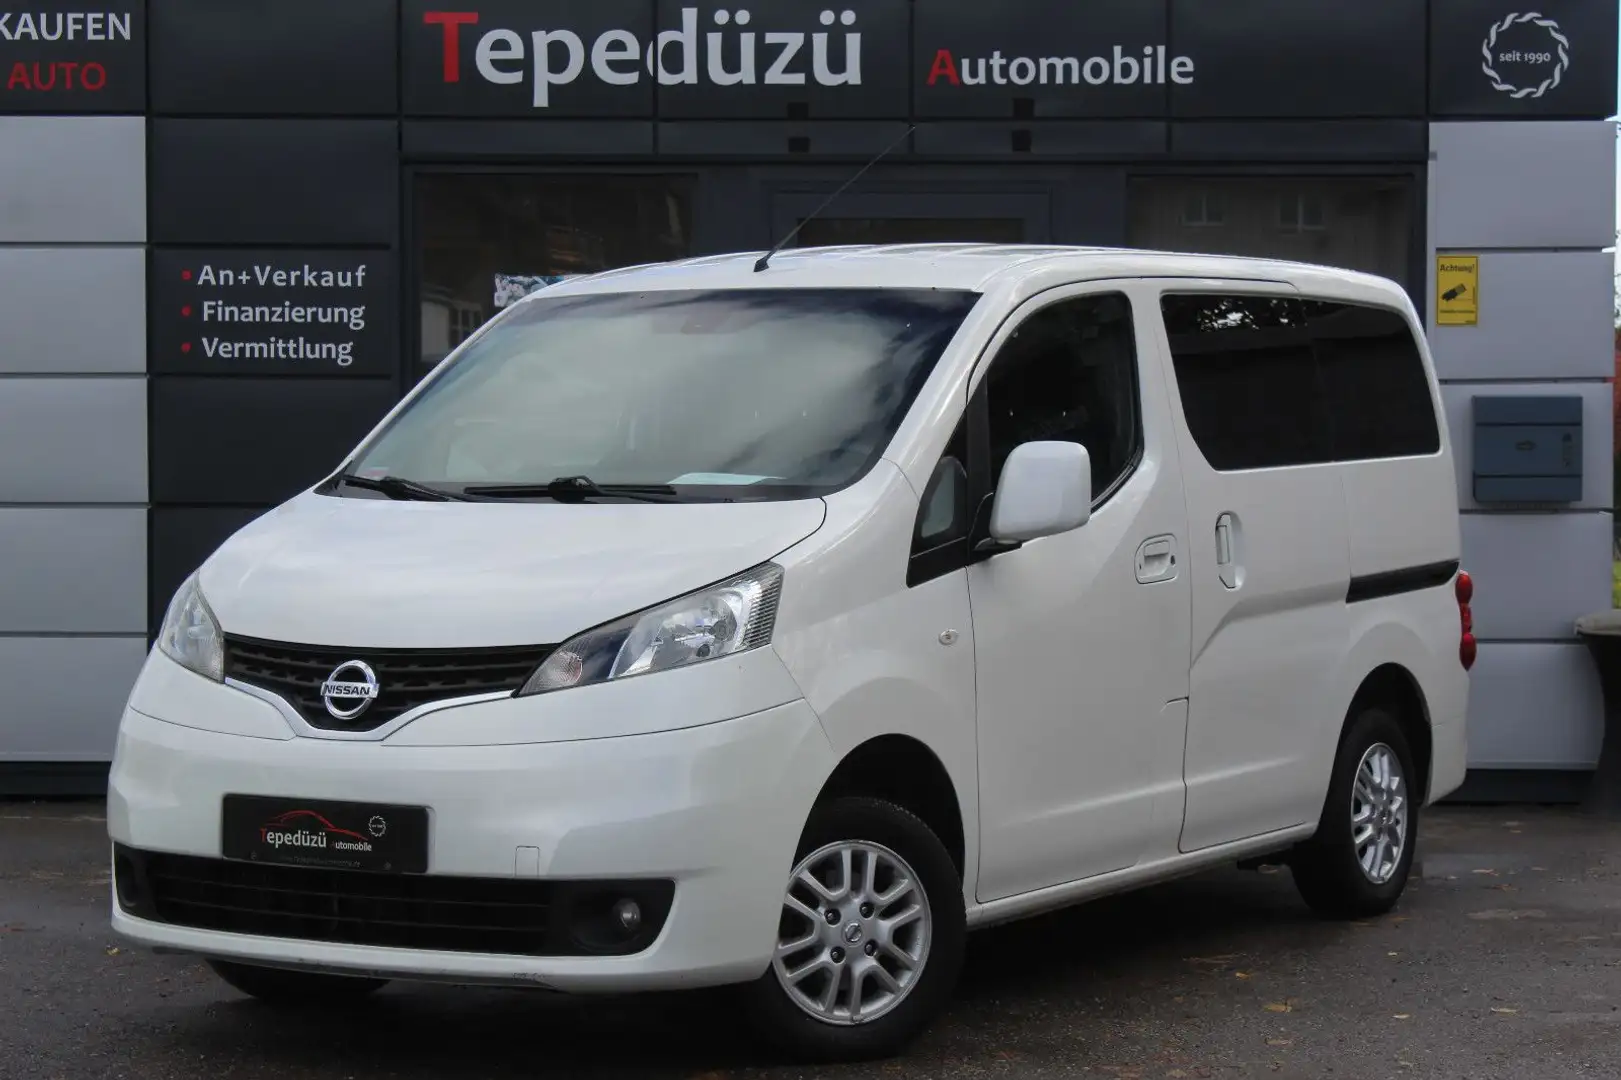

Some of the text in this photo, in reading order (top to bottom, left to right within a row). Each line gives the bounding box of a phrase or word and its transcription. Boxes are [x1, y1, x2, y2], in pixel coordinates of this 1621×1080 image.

[423, 7, 862, 108] Tepedüzü
[926, 45, 1195, 86] Automobile
[1499, 50, 1551, 64] seit 1990
[7, 62, 107, 90] AUTO
[197, 264, 366, 287] An+Verkauf
[202, 301, 366, 330] Finanzierung
[202, 337, 354, 366] Vermittlung
[325, 684, 370, 695] NISSAN
[260, 827, 327, 848] Tepedüzü
